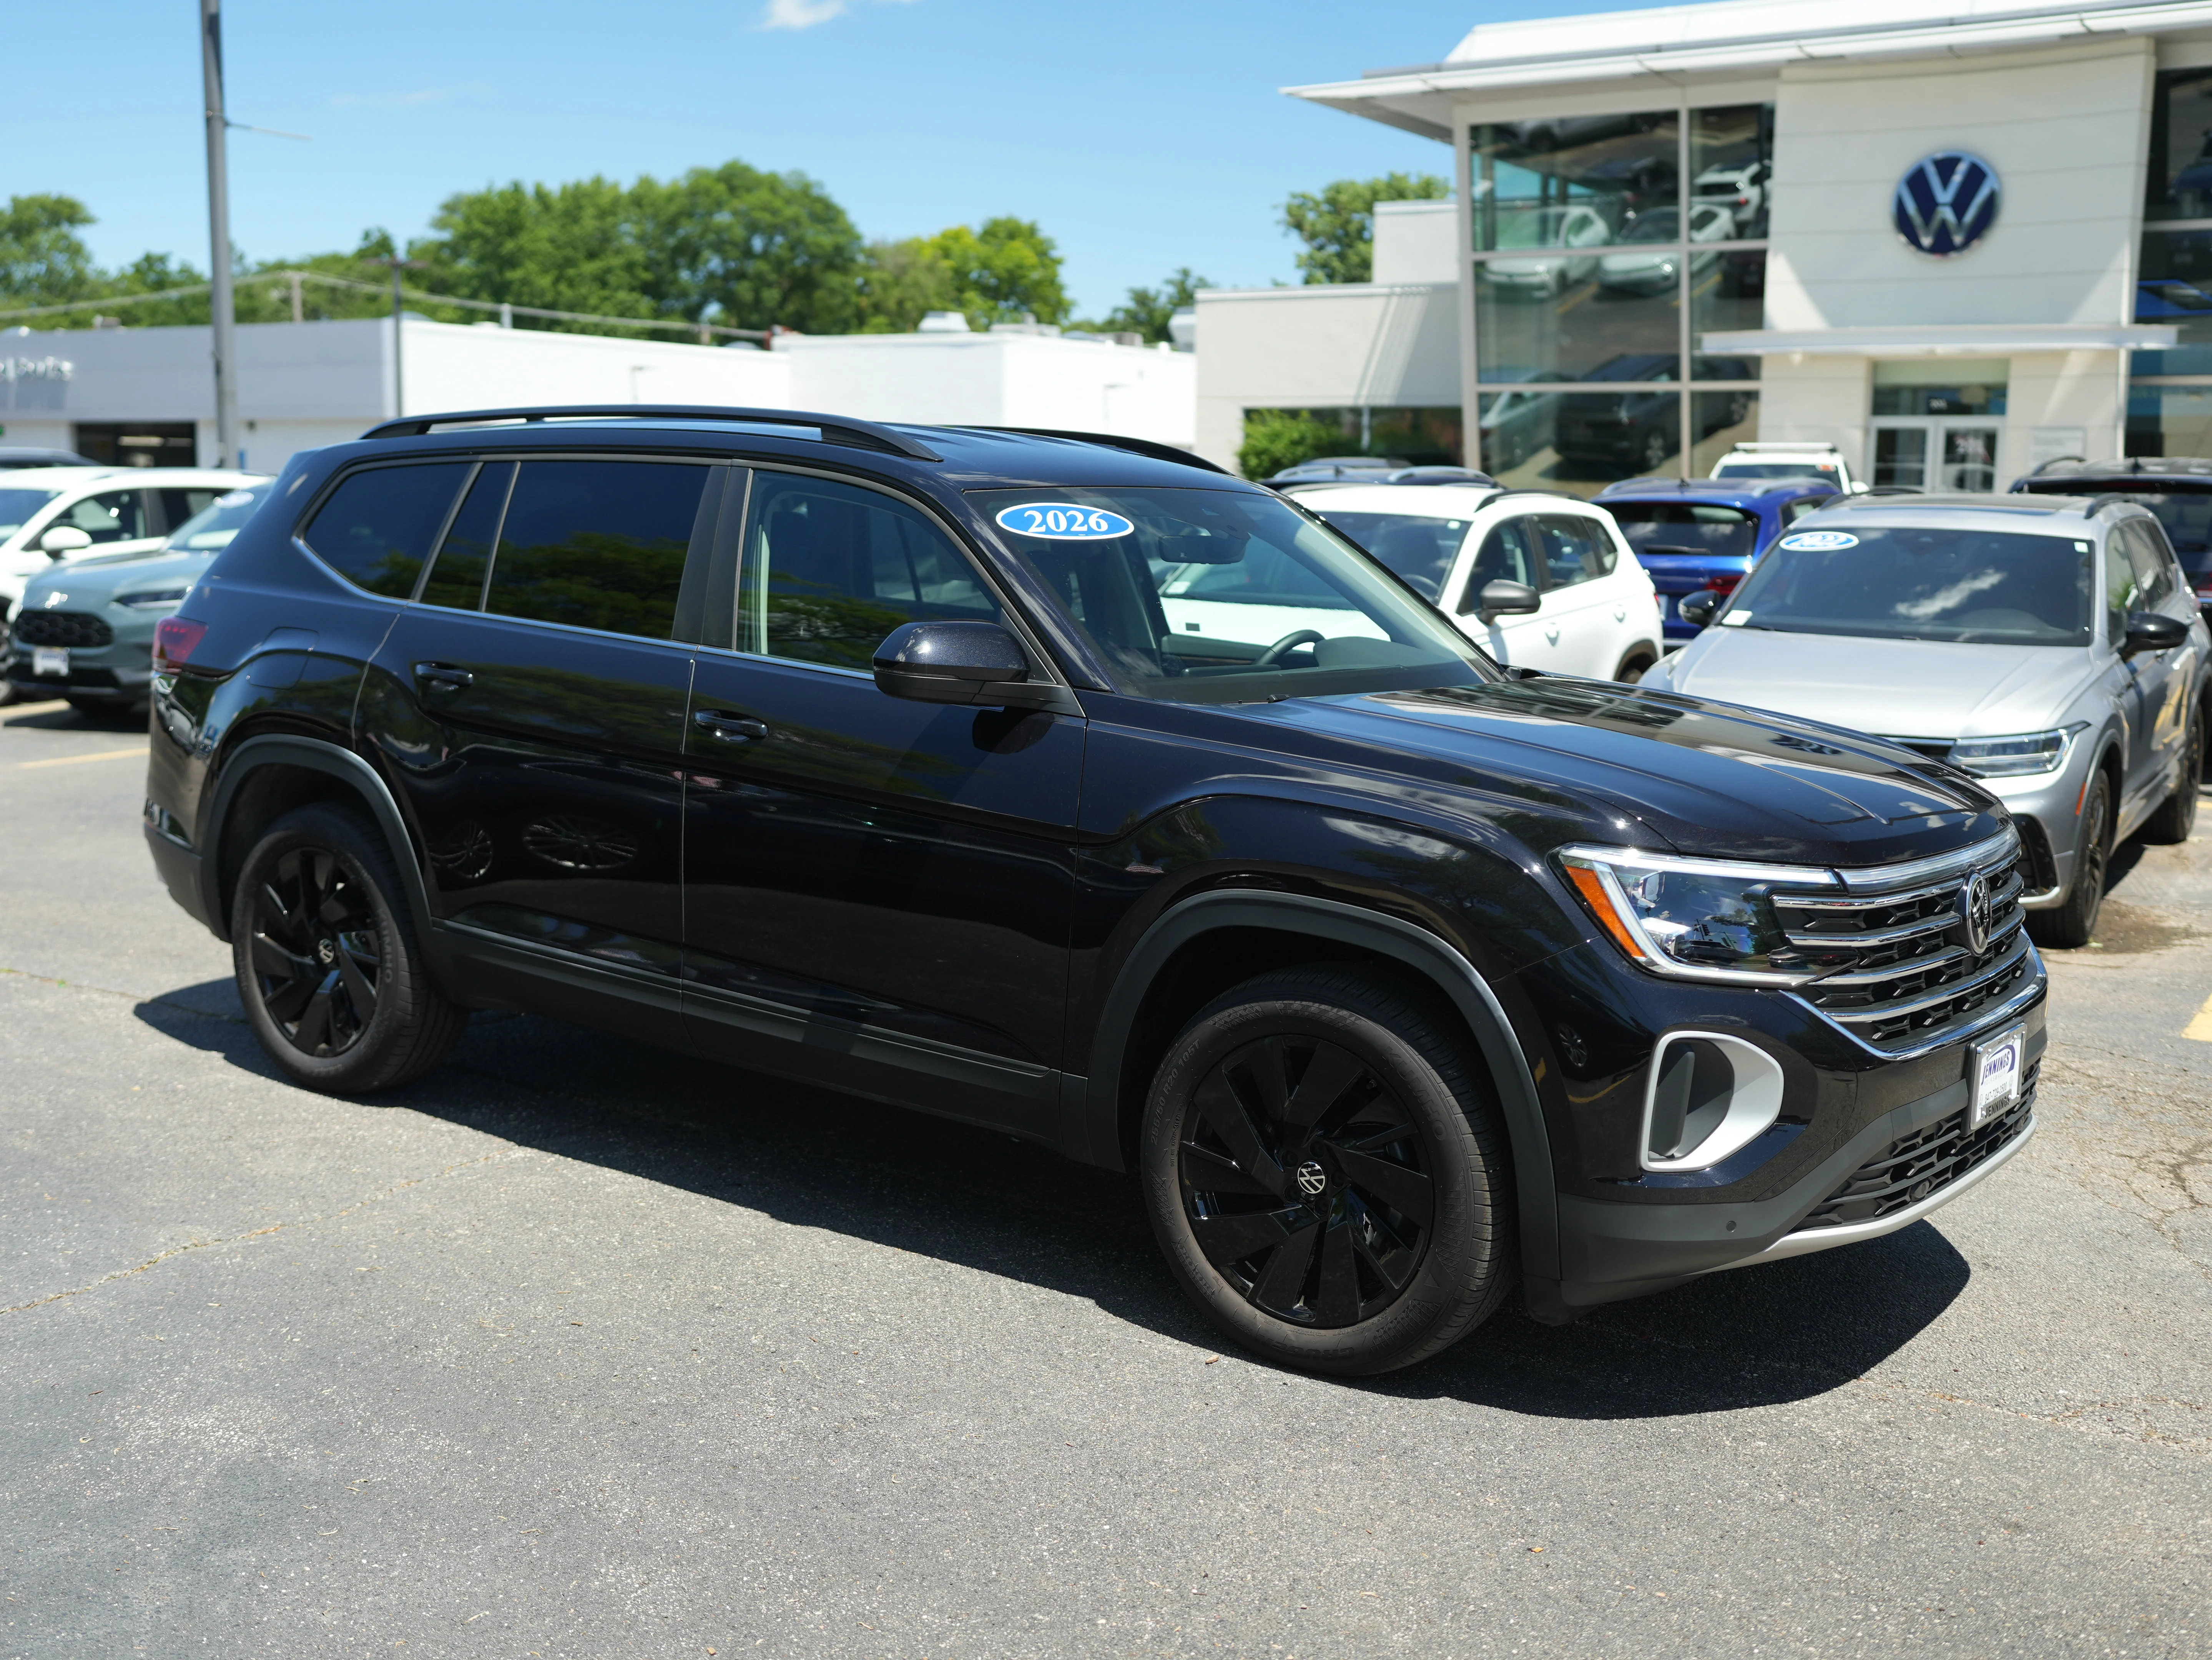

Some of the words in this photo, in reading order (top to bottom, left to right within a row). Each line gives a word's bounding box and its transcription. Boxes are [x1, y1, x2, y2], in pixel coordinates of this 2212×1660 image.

[1024, 510, 1108, 532] 2026
[1981, 1051, 2009, 1086] JENNINGS
[1151, 1095, 1166, 1145] 255/50
[1163, 1067, 1179, 1095] R20
[1178, 1038, 1201, 1067] 105T
[1384, 1046, 1446, 1140] KUMHO
[1984, 1094, 2010, 1119] JENNINGS
